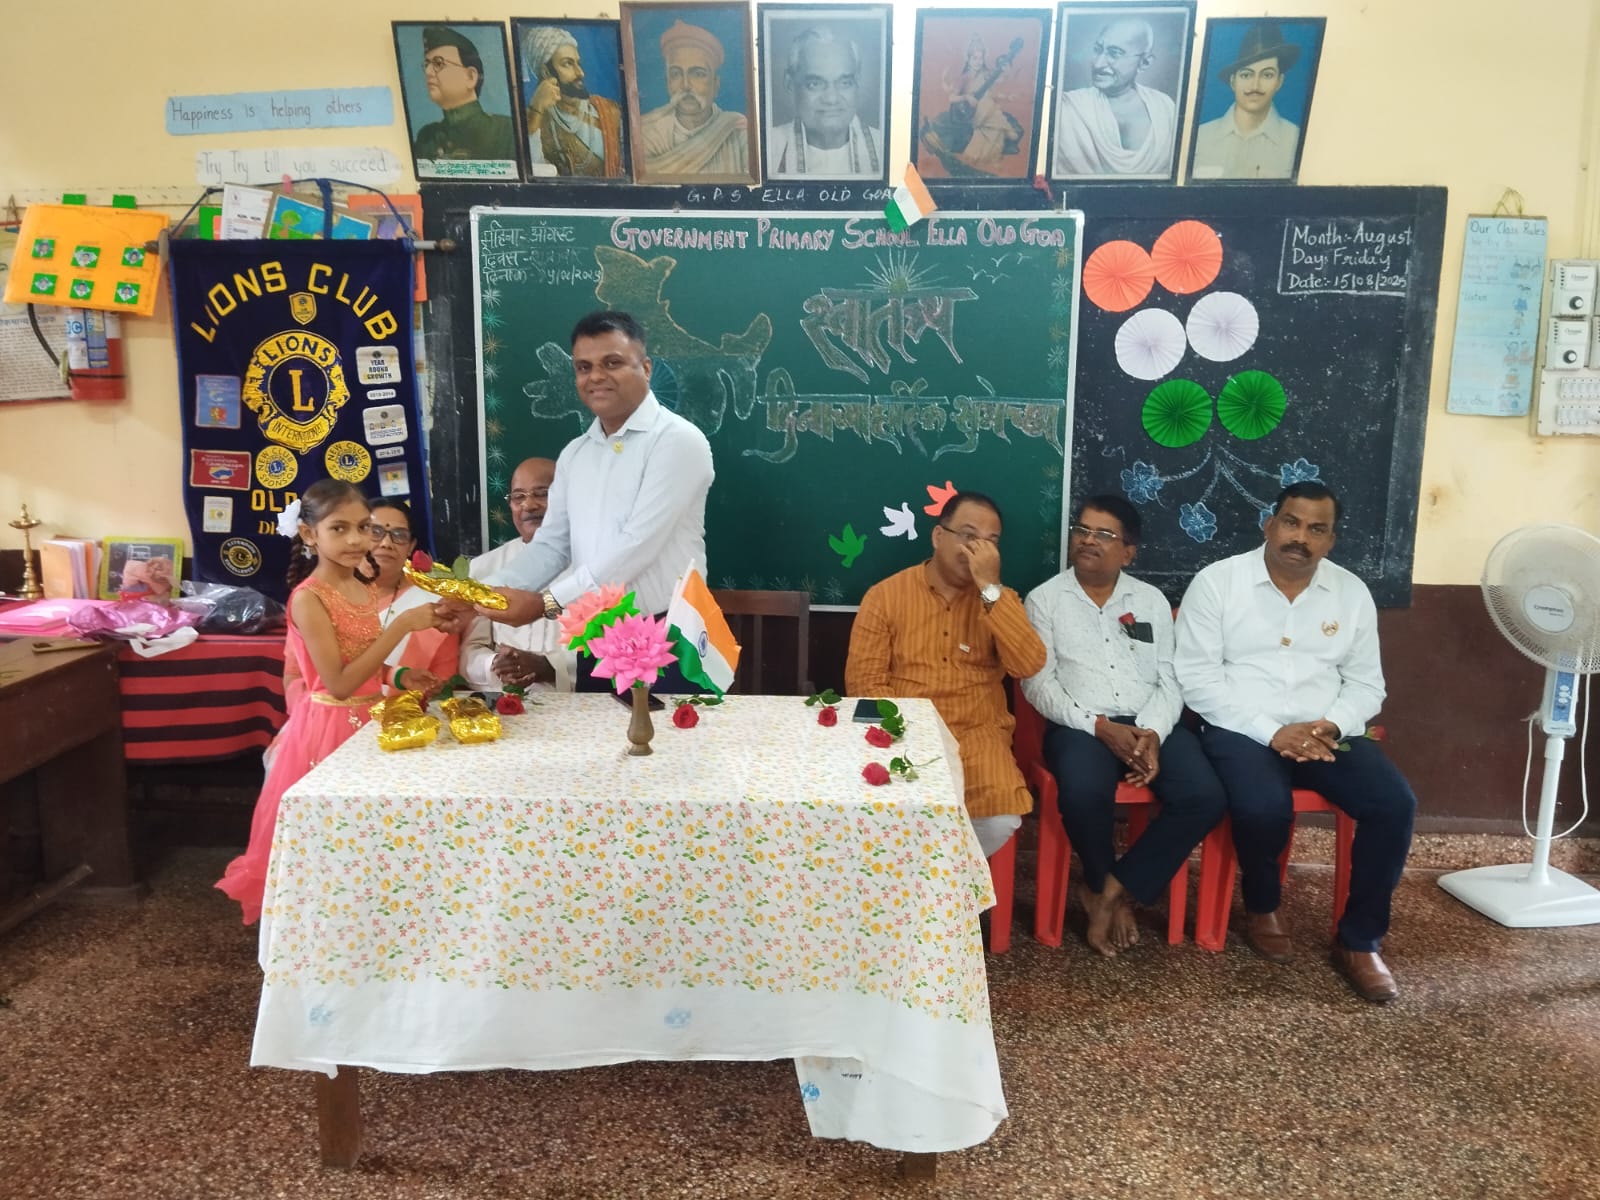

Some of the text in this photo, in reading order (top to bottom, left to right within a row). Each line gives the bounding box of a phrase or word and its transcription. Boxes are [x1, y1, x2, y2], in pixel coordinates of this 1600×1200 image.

[171, 96, 362, 130] Happiness is helping others
[202, 150, 388, 184] Try Try till you succeed
[762, 187, 806, 203] ELLA
[819, 187, 851, 202] OLD
[610, 215, 749, 251] GOVERNMENT
[757, 217, 835, 251] PRIMARY
[927, 217, 967, 246] ELLA
[976, 216, 1017, 247] OLD
[1019, 217, 1066, 248] GOA
[1470, 220, 1489, 234] Our
[1333, 246, 1391, 273] Friday
[191, 261, 399, 344] LIONS CLUB
[262, 335, 332, 363] LIONS
[288, 369, 315, 412] L
[257, 452, 270, 471] NEW
[271, 447, 293, 463] CLUB
[327, 444, 342, 462] NEW
[346, 442, 369, 461] CLUB
[259, 465, 296, 487] SPONSOR
